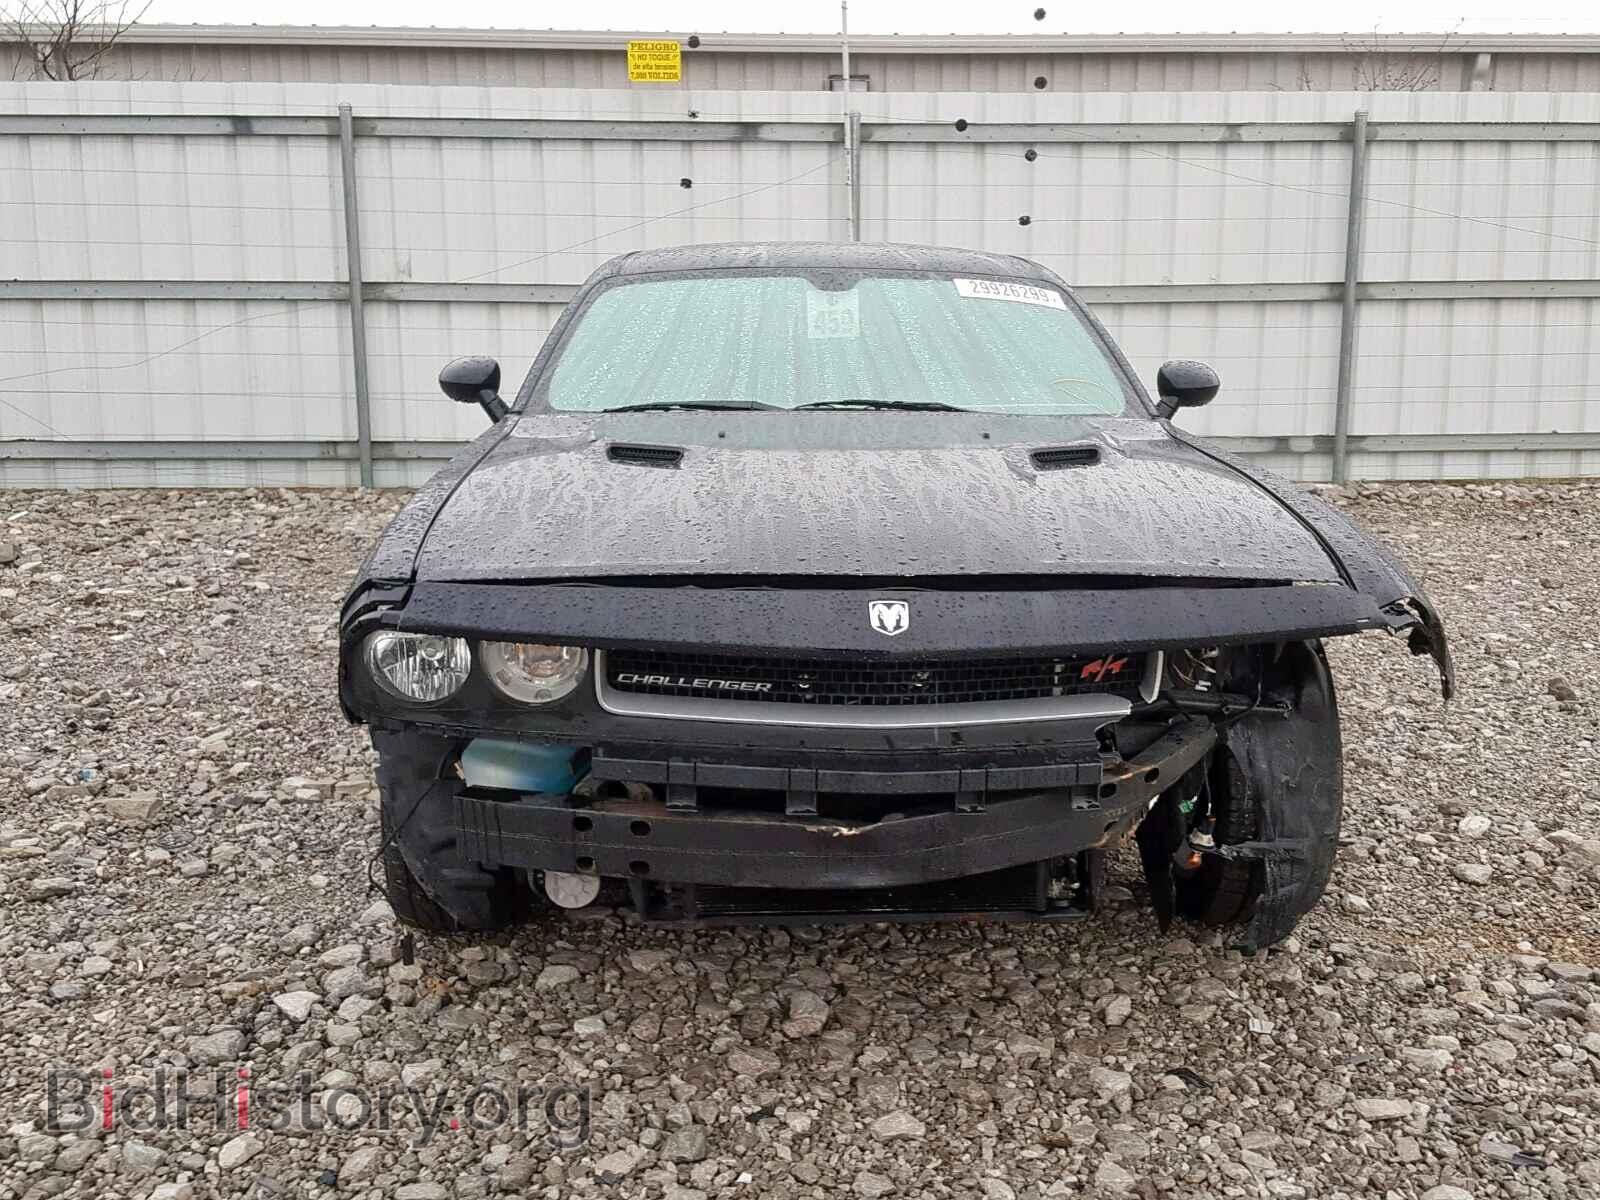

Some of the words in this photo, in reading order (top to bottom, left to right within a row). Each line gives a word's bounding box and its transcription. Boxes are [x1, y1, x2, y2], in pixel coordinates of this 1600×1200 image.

[631, 43, 678, 51] PELIGRO
[1080, 655, 1129, 682] R/T
[617, 673, 772, 692] CHALLENGER
